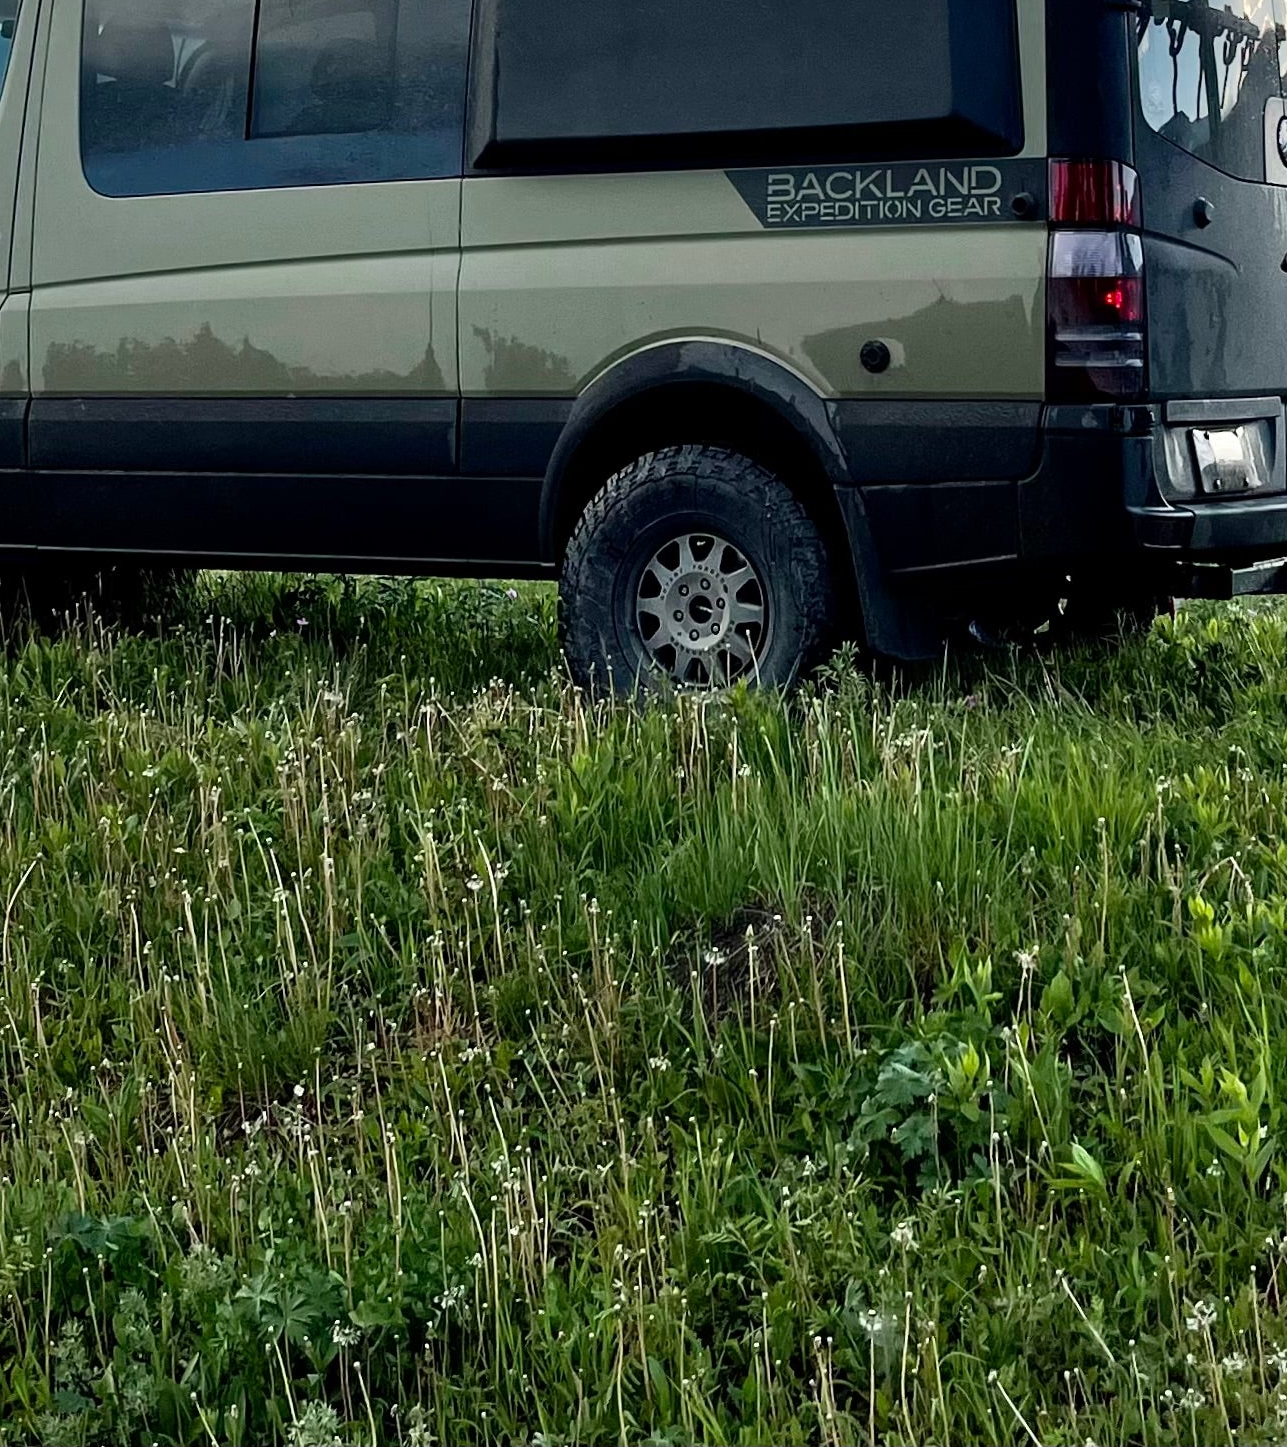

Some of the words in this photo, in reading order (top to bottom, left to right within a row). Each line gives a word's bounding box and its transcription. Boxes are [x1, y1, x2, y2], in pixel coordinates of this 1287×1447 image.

[767, 166, 1002, 201] BACKLAND
[767, 200, 921, 223] EXPEDITION
[929, 196, 1001, 217] GEAR
